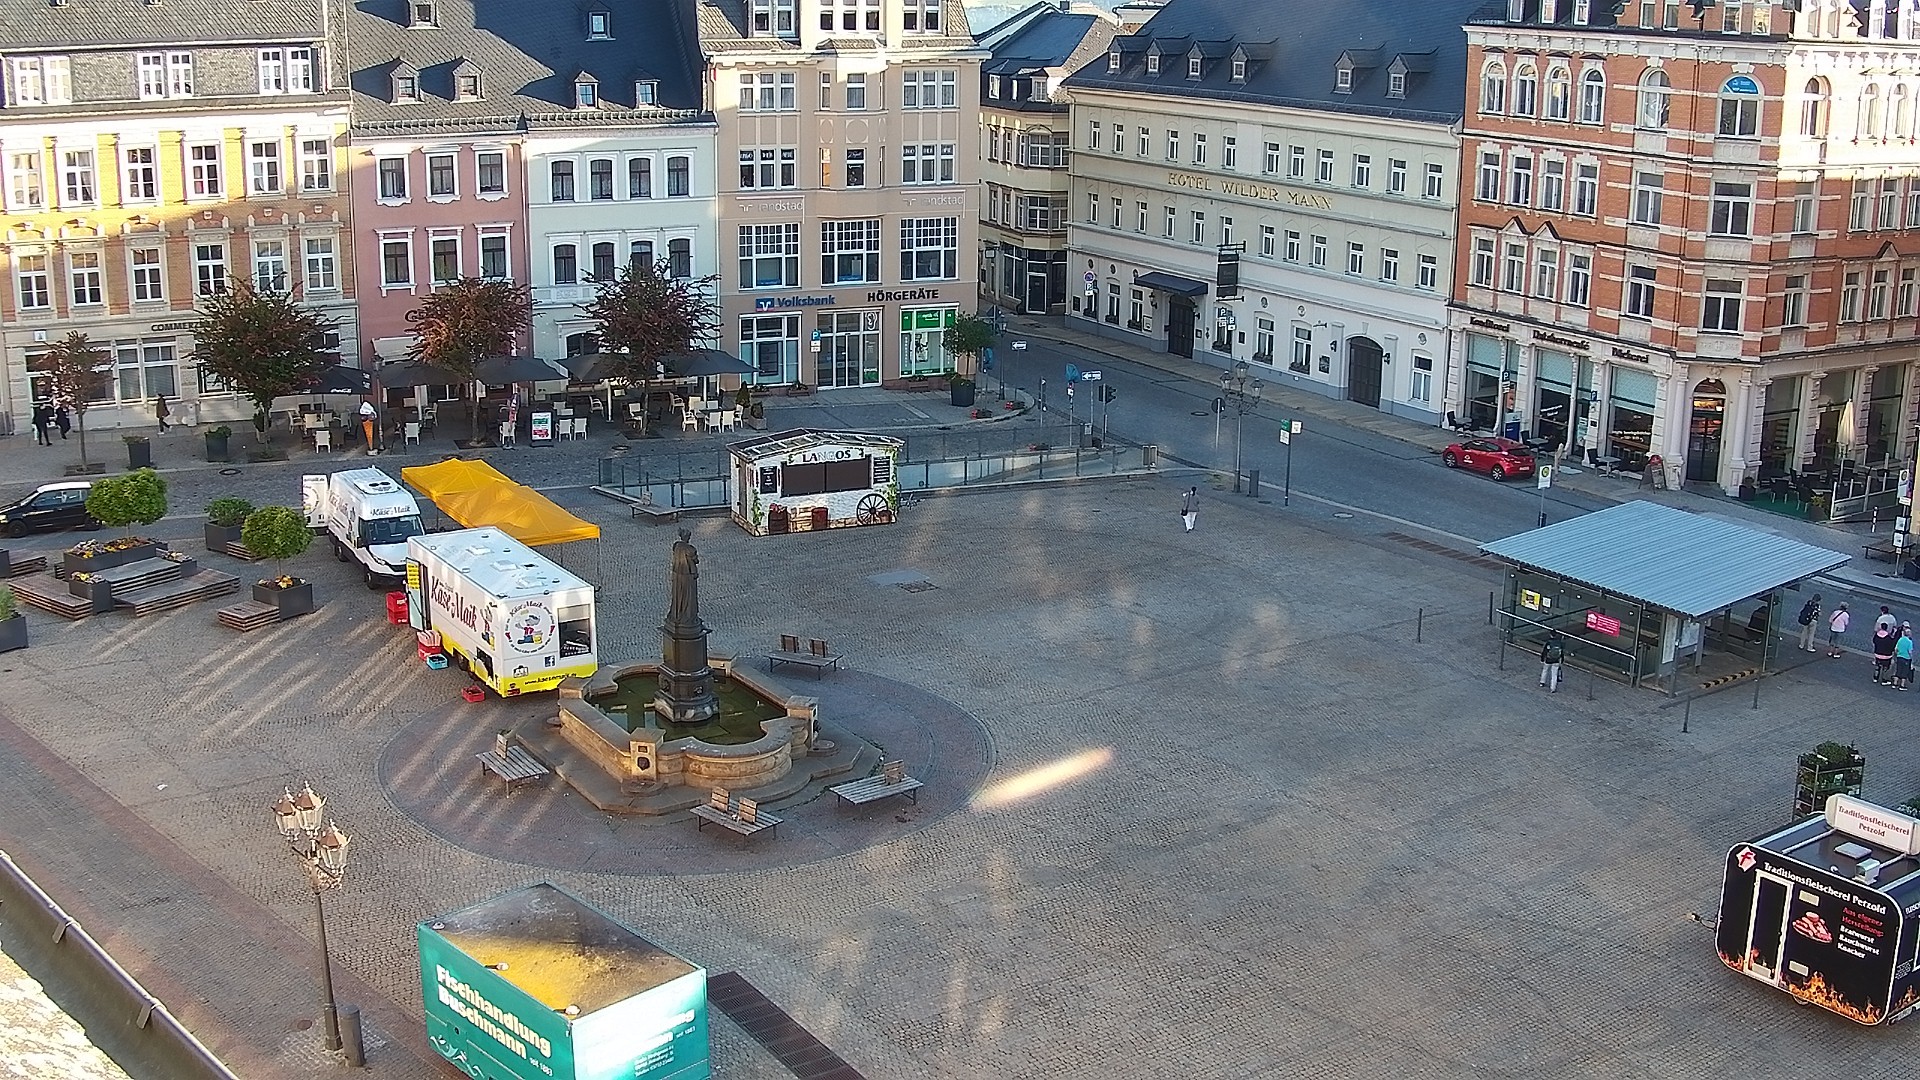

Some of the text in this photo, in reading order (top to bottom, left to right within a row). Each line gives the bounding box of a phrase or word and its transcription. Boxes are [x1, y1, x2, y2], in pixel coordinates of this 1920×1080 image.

[921, 194, 964, 206] andstad
[1168, 173, 1332, 210] HOTEL WILDER MANN
[778, 295, 836, 307] Volksbank
[867, 289, 939, 302] HÖRGERÄTE
[151, 322, 201, 331] COMMERZ
[1838, 805, 1910, 836] Traditionsfleischerei
[1858, 822, 1886, 837] Petzold
[1764, 862, 1887, 915] Traditionsfleischerei Petzold
[436, 964, 552, 1059] Fischhandlung
[438, 984, 527, 1060] Buschmann
